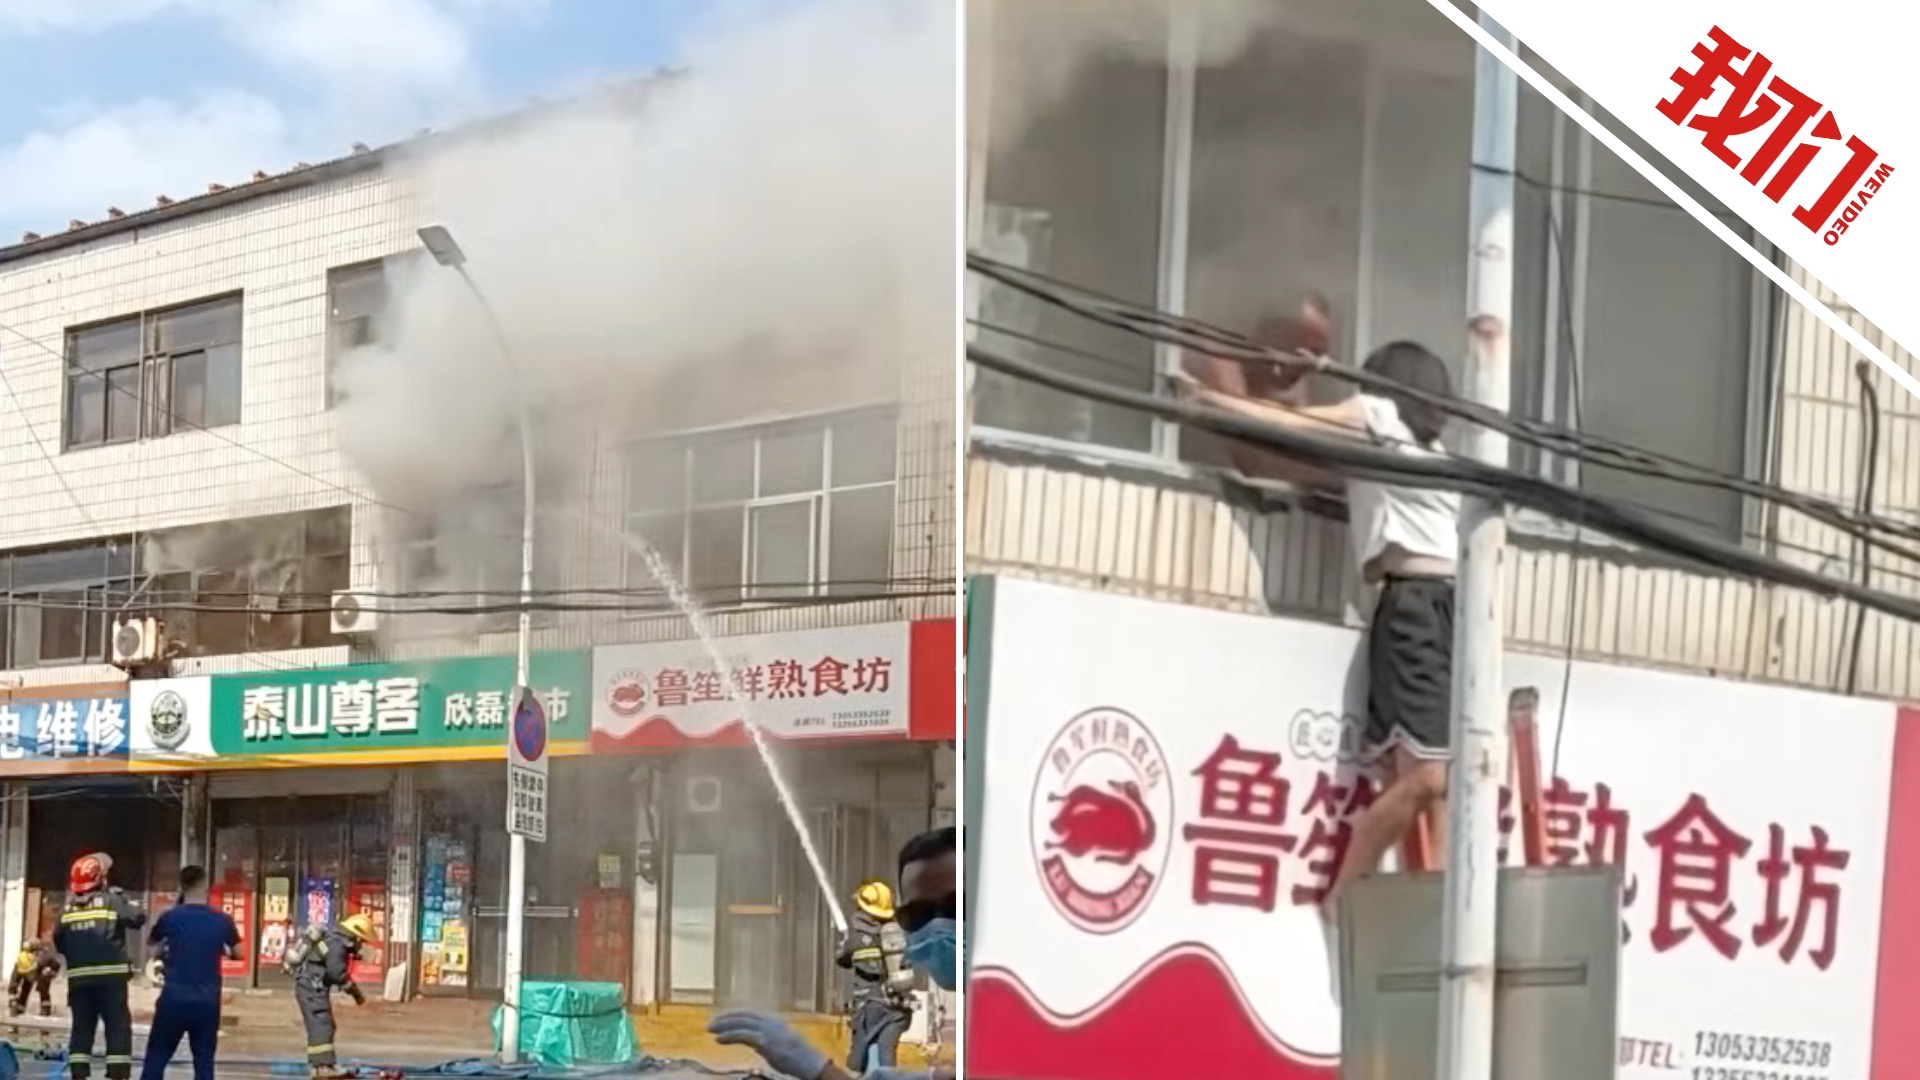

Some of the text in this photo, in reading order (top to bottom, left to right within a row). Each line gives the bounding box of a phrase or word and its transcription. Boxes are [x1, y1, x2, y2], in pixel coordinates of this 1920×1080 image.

[243, 677, 419, 741] 泰山尊客
[444, 687, 571, 727] 欣磊市
[1695, 1030, 1832, 1068] 13053352538
